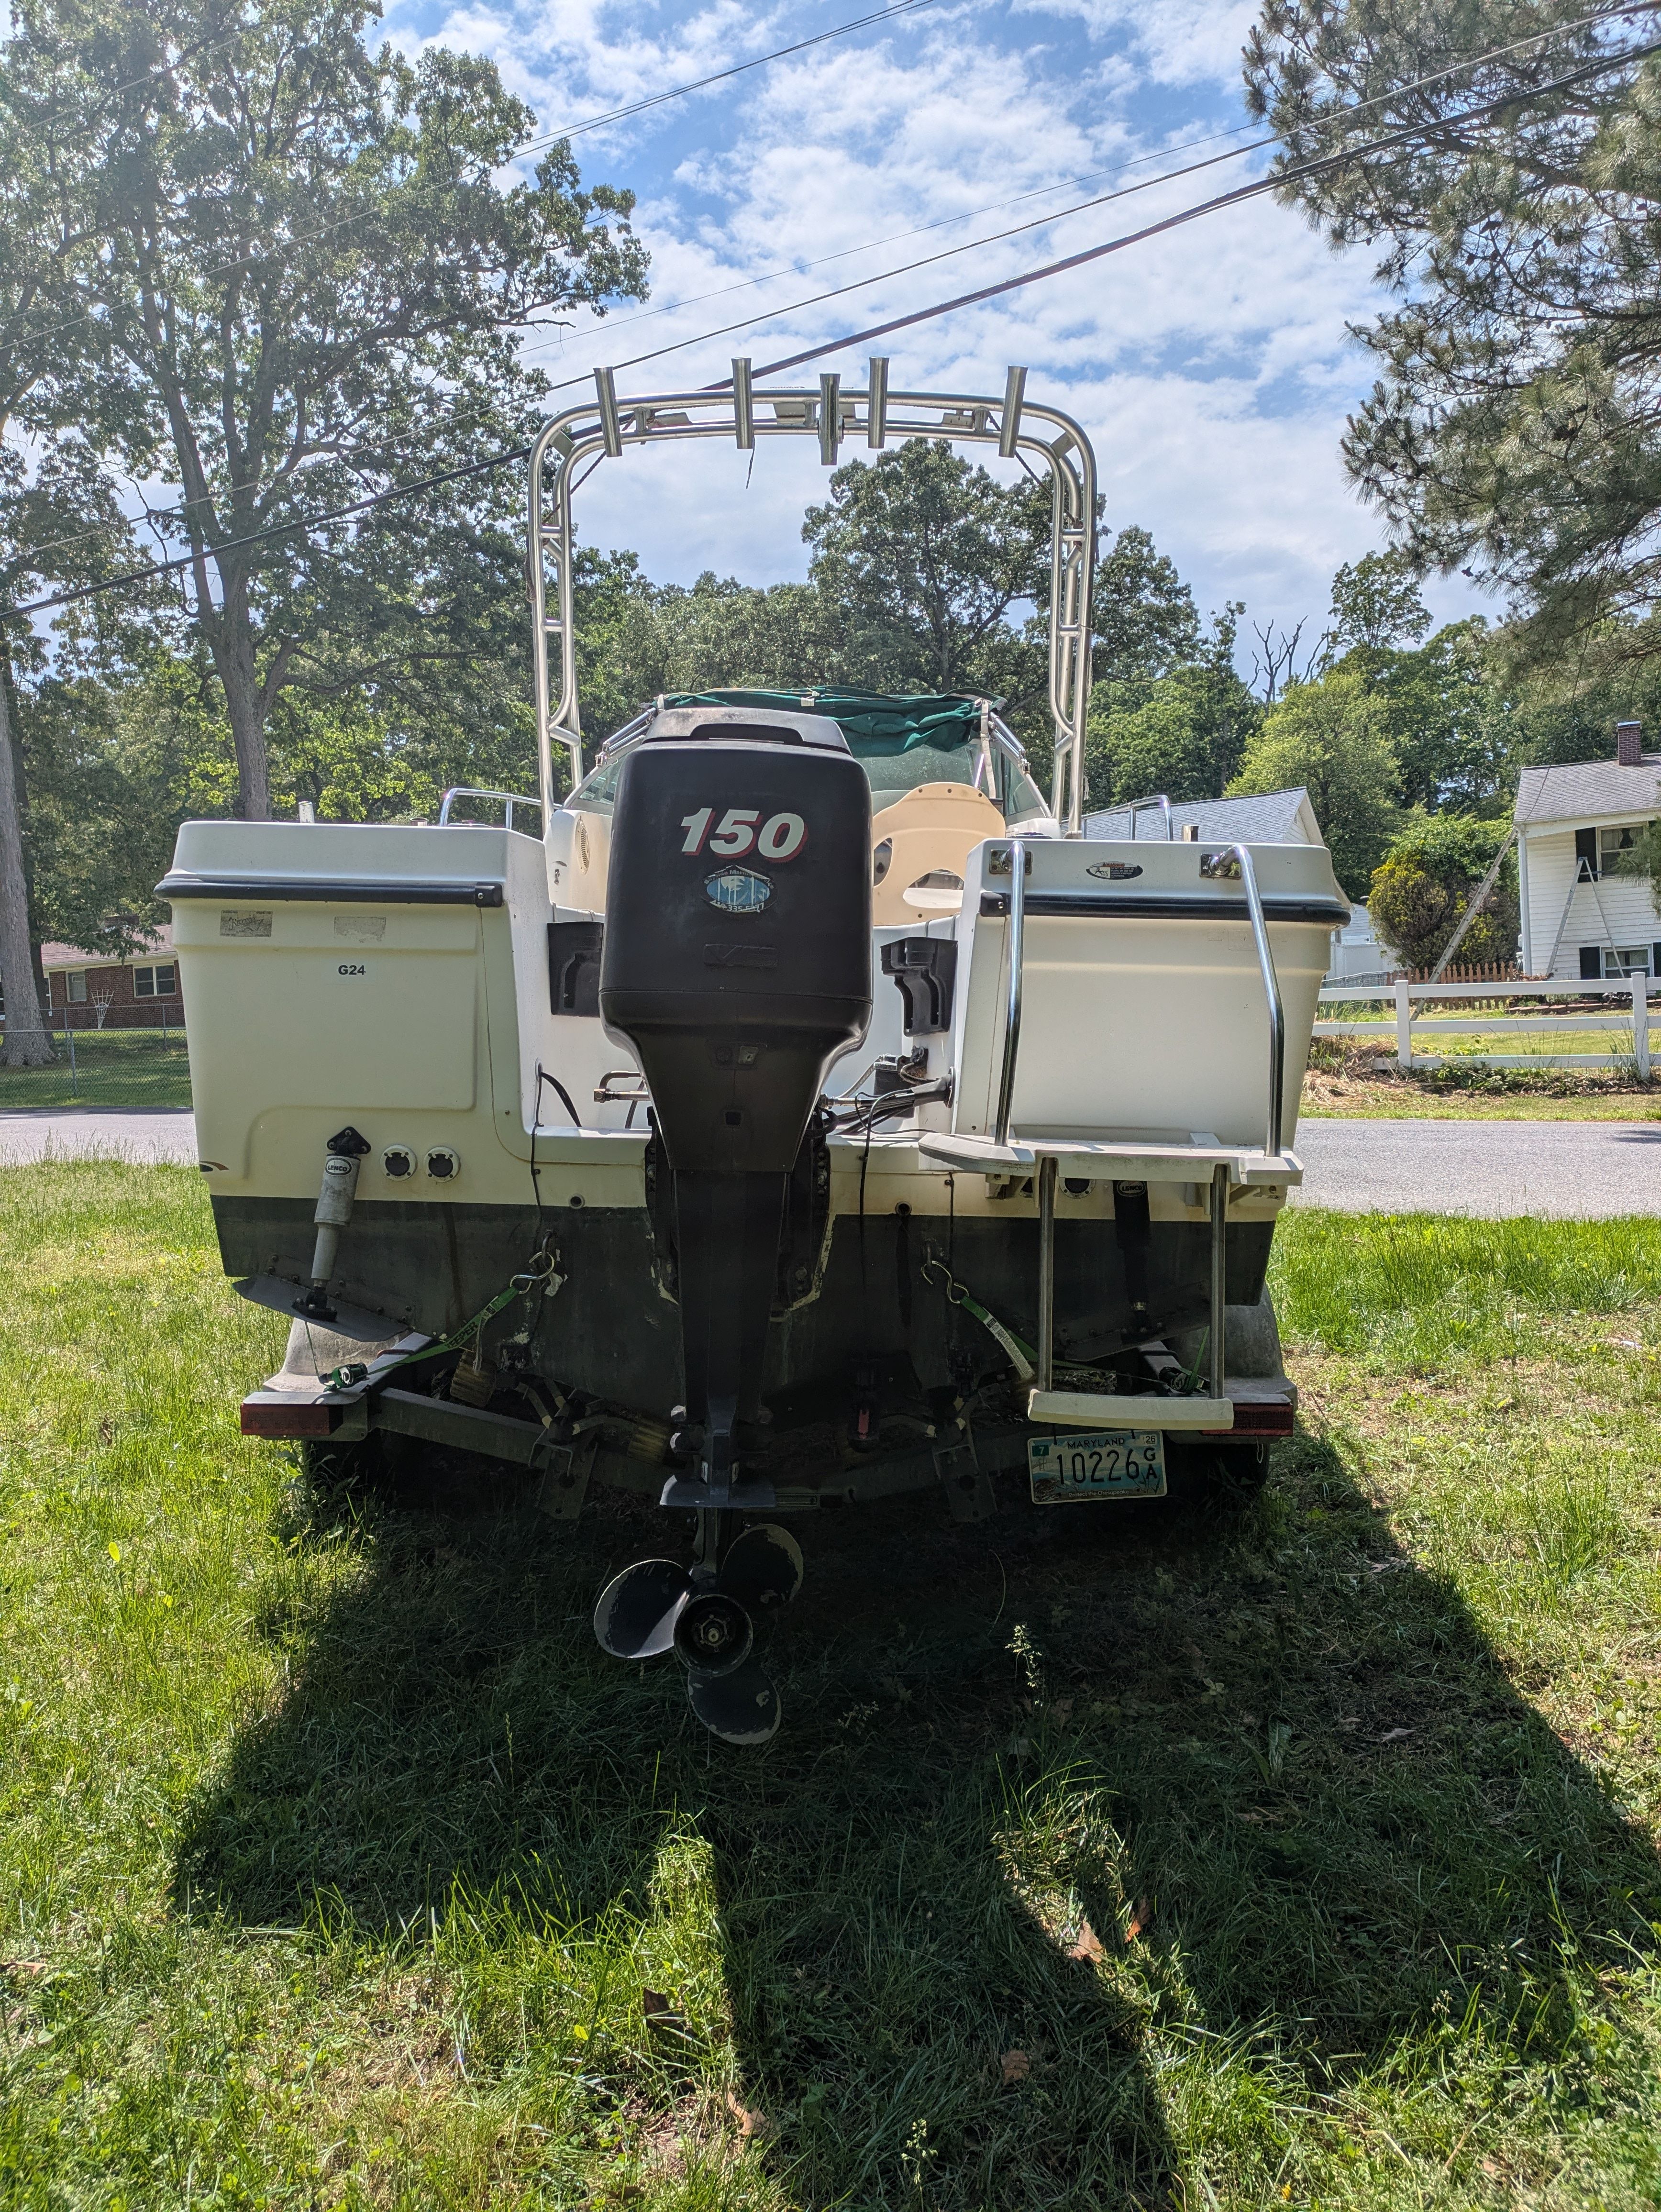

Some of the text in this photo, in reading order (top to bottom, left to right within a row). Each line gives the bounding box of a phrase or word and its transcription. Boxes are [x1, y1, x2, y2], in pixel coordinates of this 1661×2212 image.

[681, 807, 808, 863] 150
[338, 964, 365, 975] G24
[1067, 1438, 1125, 1449] MARYLAND
[1039, 1446, 1045, 1455] 7
[1056, 1449, 1140, 1485] 10226
